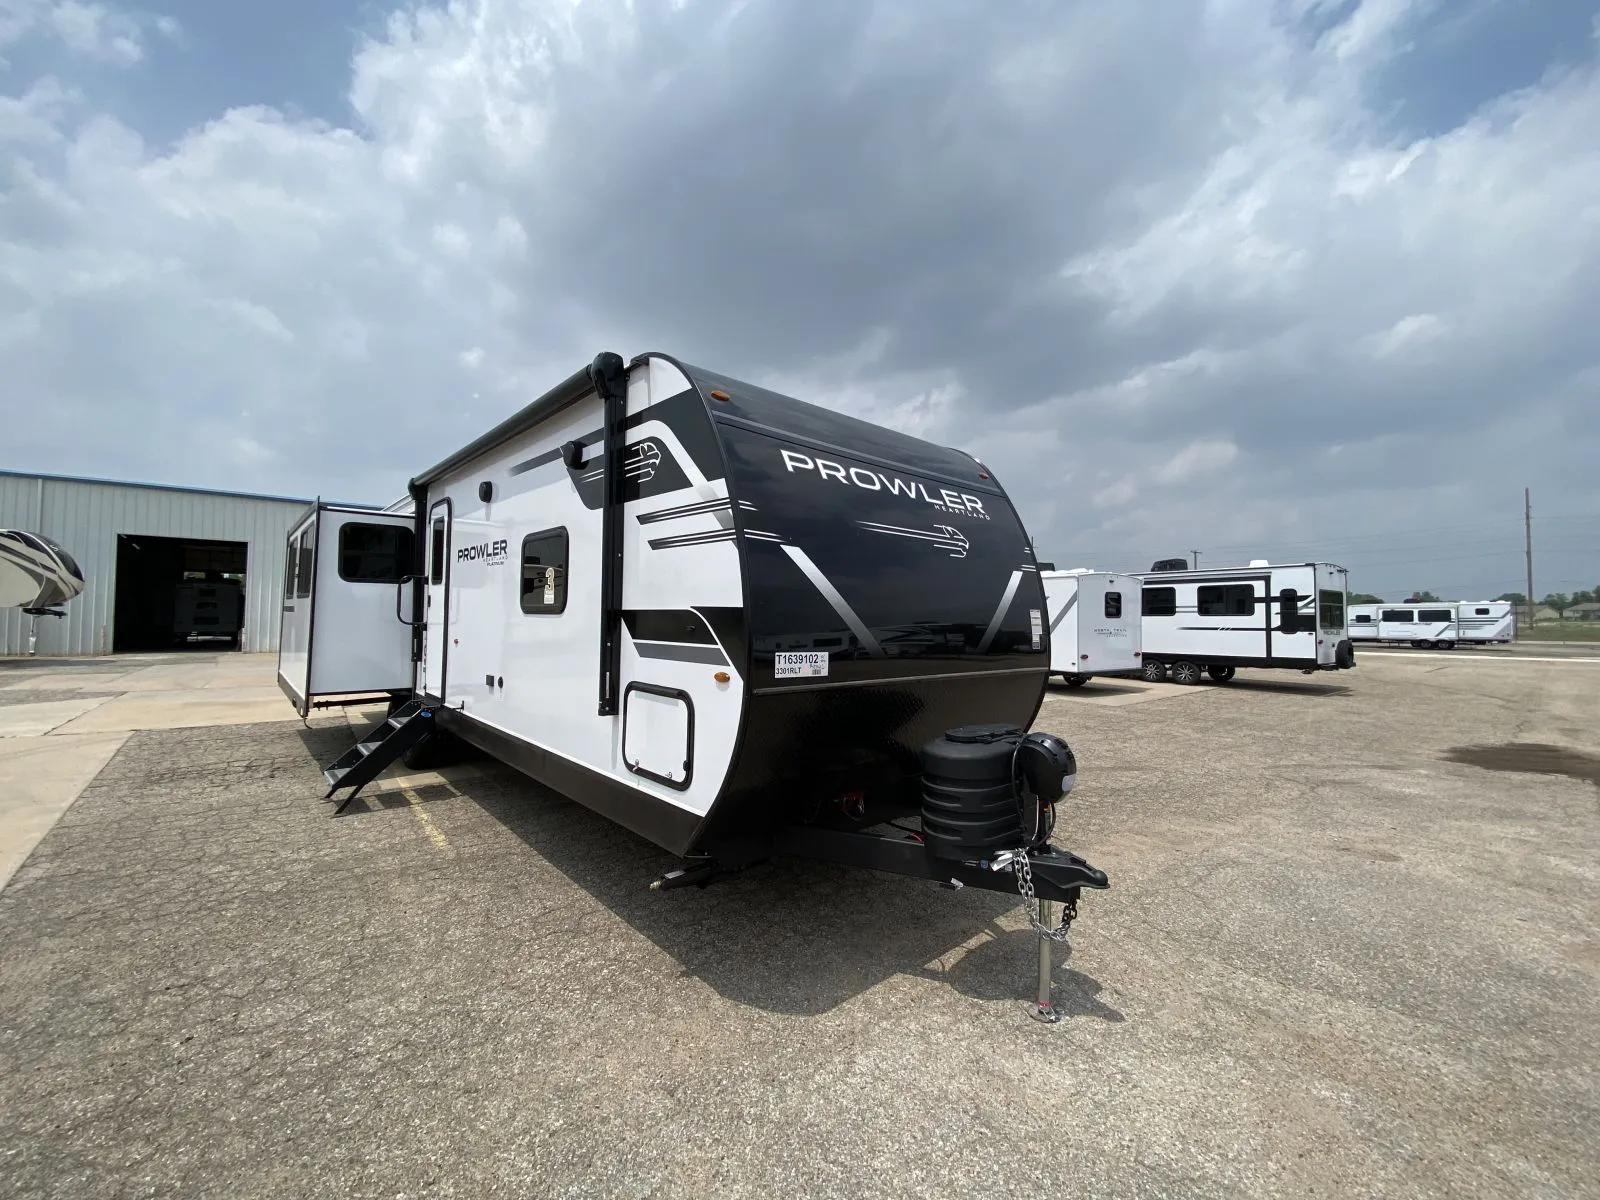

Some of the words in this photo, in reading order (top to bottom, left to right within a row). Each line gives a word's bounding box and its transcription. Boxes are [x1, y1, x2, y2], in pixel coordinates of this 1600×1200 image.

[780, 449, 986, 514] PROWLER
[934, 504, 990, 520] HEARTLAND
[457, 539, 507, 562] PROWLER
[776, 654, 819, 664] T1639102
